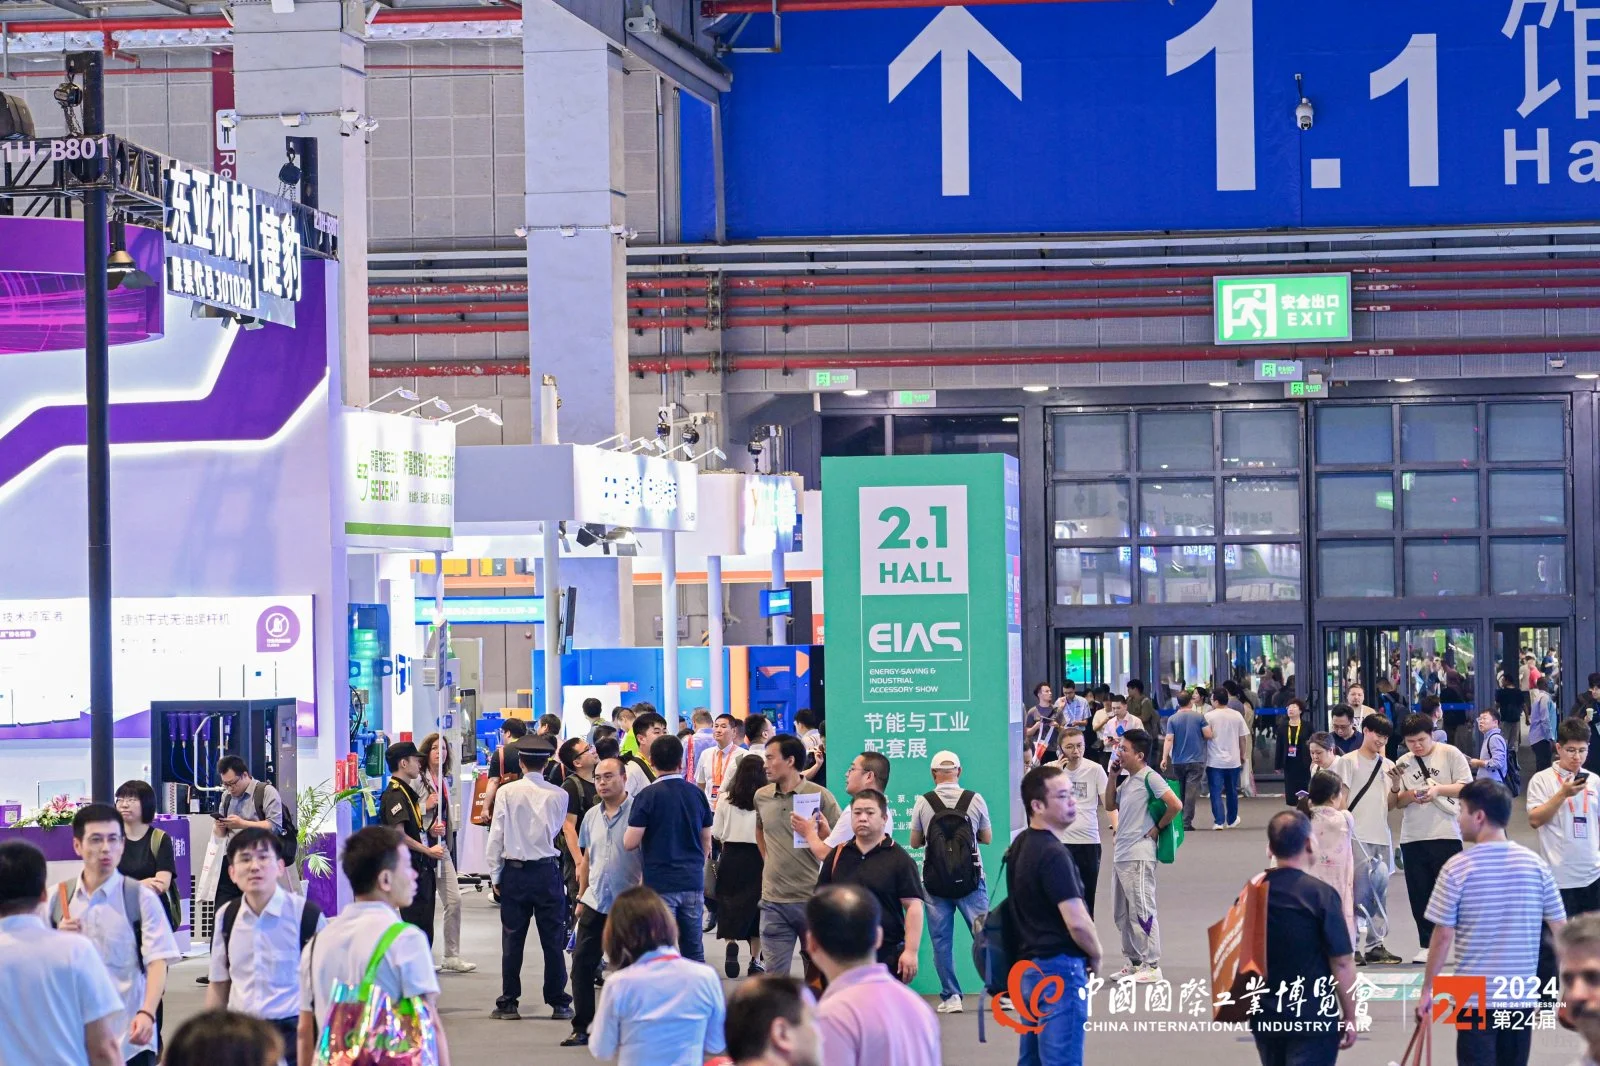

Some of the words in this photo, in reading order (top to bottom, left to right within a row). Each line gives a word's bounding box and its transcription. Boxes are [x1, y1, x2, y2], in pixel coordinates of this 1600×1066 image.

[170, 160, 251, 265] 东亚机械
[260, 204, 302, 302] 捷豹
[1280, 294, 1340, 310] 安全出口
[1287, 311, 1336, 326] EXIT
[877, 506, 948, 550] 2.1
[879, 561, 952, 584] HALL
[868, 621, 963, 653] EIAS
[869, 667, 929, 675] ENERGY-SAVING
[869, 686, 913, 694] ACCESSORY
[915, 685, 939, 693] SHOW
[863, 711, 970, 733] 节能与工业
[863, 738, 928, 759] 配套展
